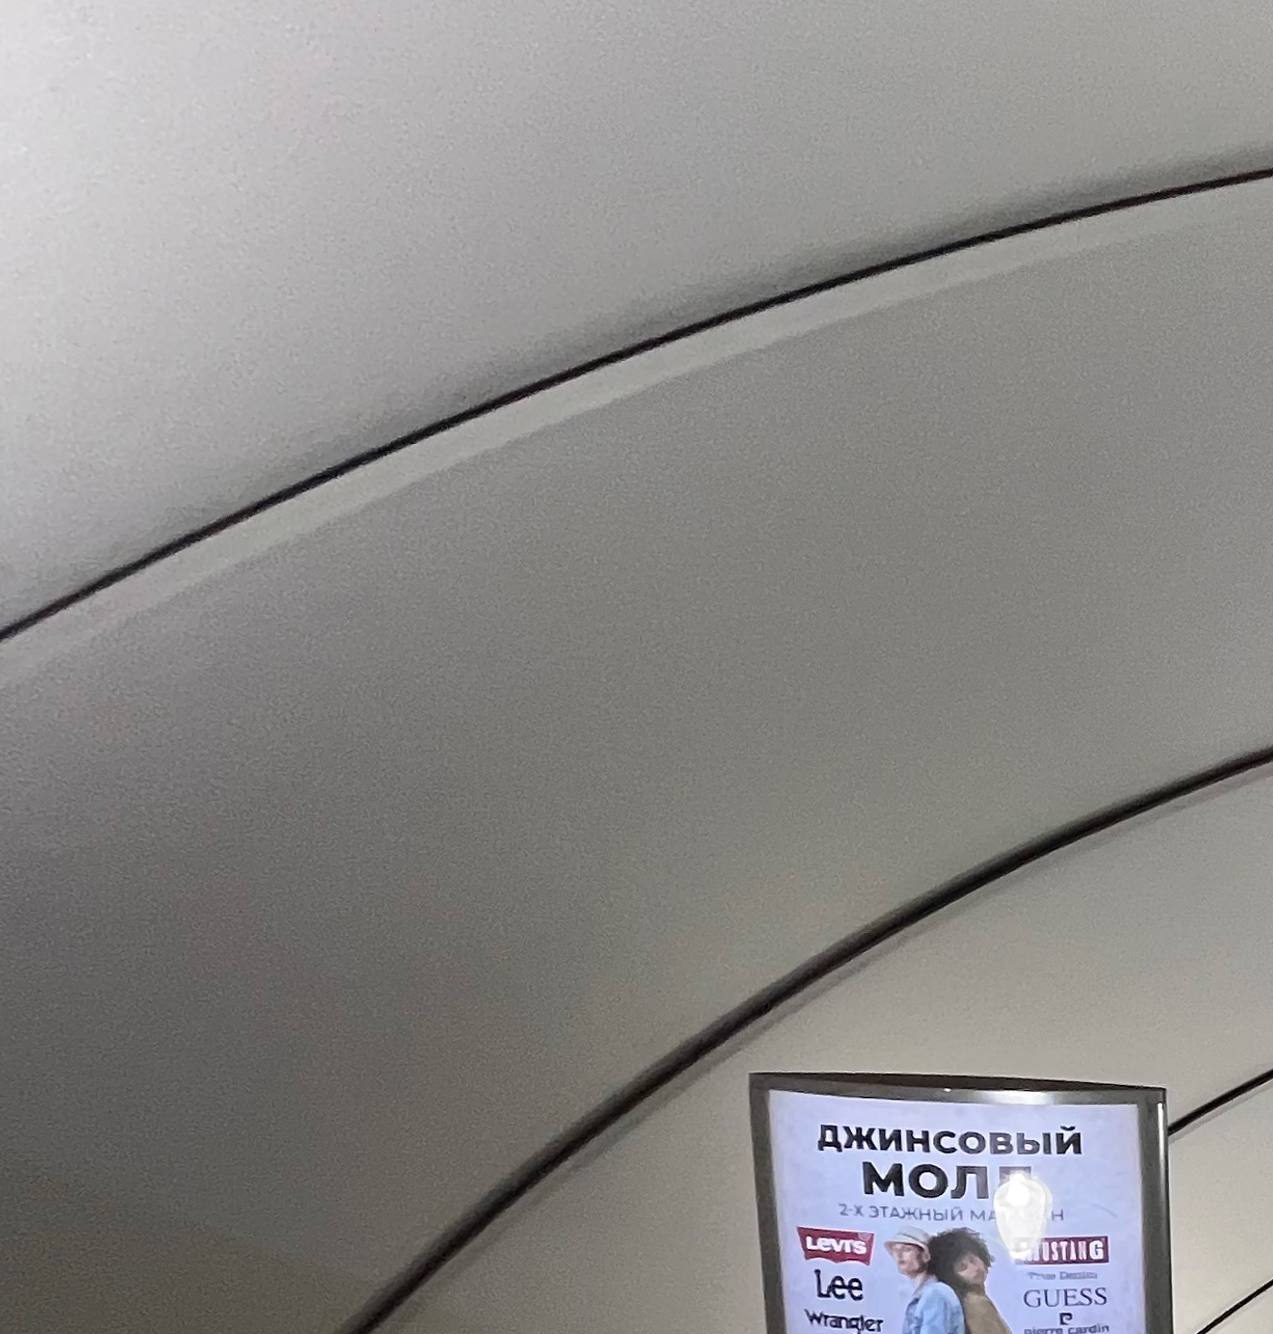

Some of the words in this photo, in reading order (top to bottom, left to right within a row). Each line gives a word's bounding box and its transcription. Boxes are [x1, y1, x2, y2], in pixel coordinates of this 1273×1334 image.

[817, 1124, 1082, 1155] ДЖИНСОВЫЙ
[870, 1205, 963, 1221] ЭТАЖНЫЙ
[814, 1269, 864, 1301] Lee
[1023, 1287, 1108, 1308] GUESS
[1068, 1323, 1110, 1334] cardin
